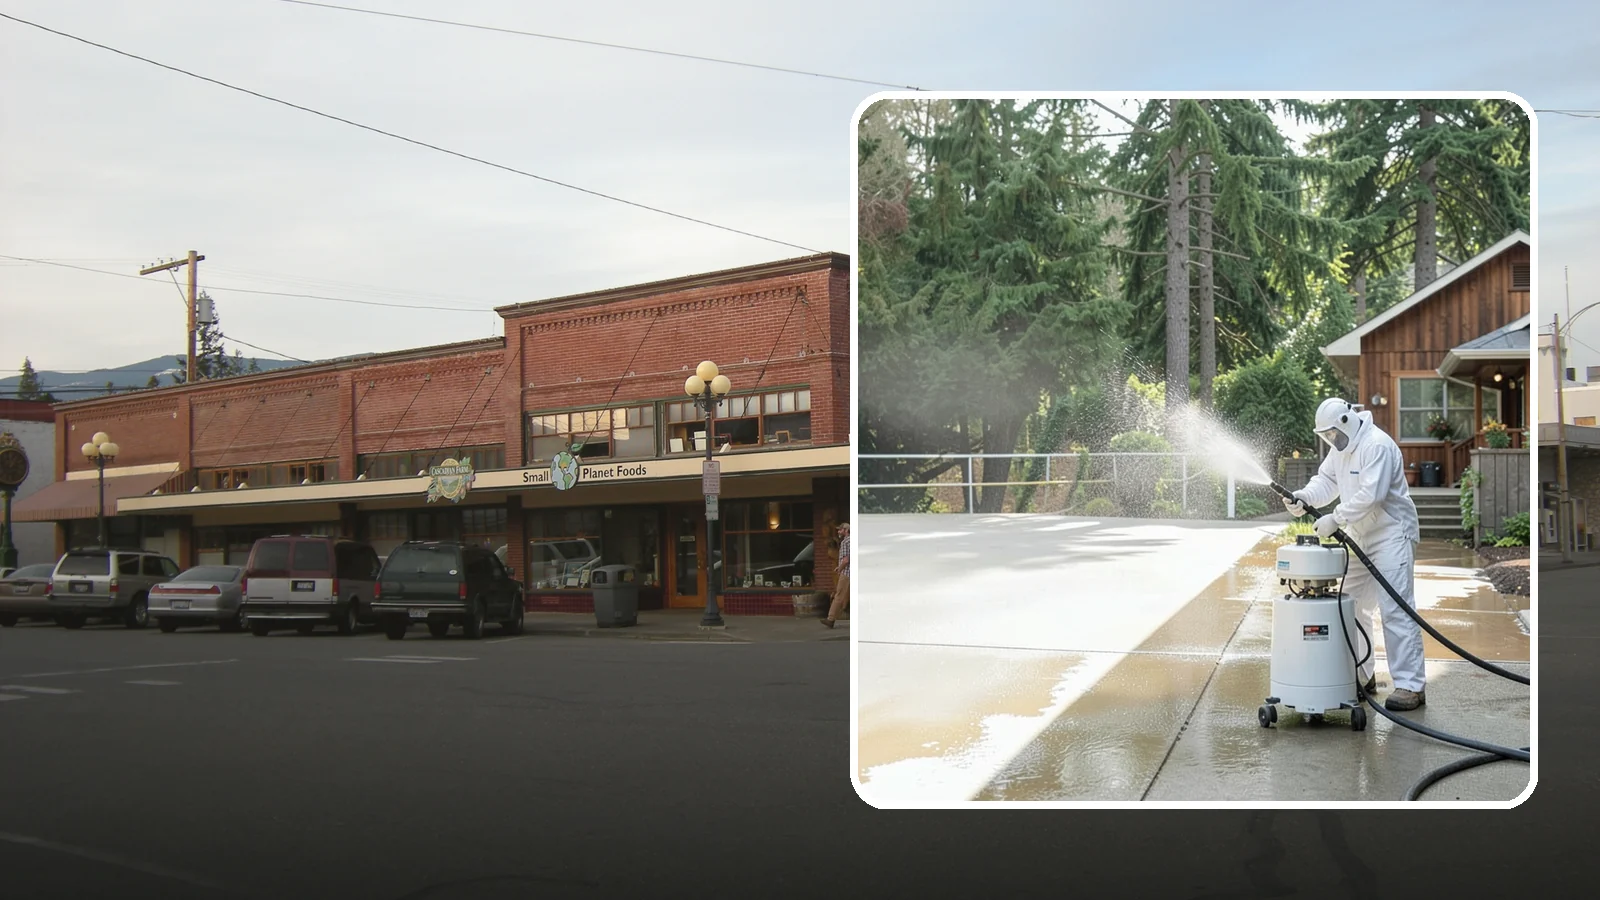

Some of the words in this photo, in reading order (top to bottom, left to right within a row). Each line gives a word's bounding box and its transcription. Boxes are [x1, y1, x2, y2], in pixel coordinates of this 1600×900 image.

[523, 471, 549, 483] Small
[582, 468, 614, 479] Planet
[616, 464, 647, 476] Foods
